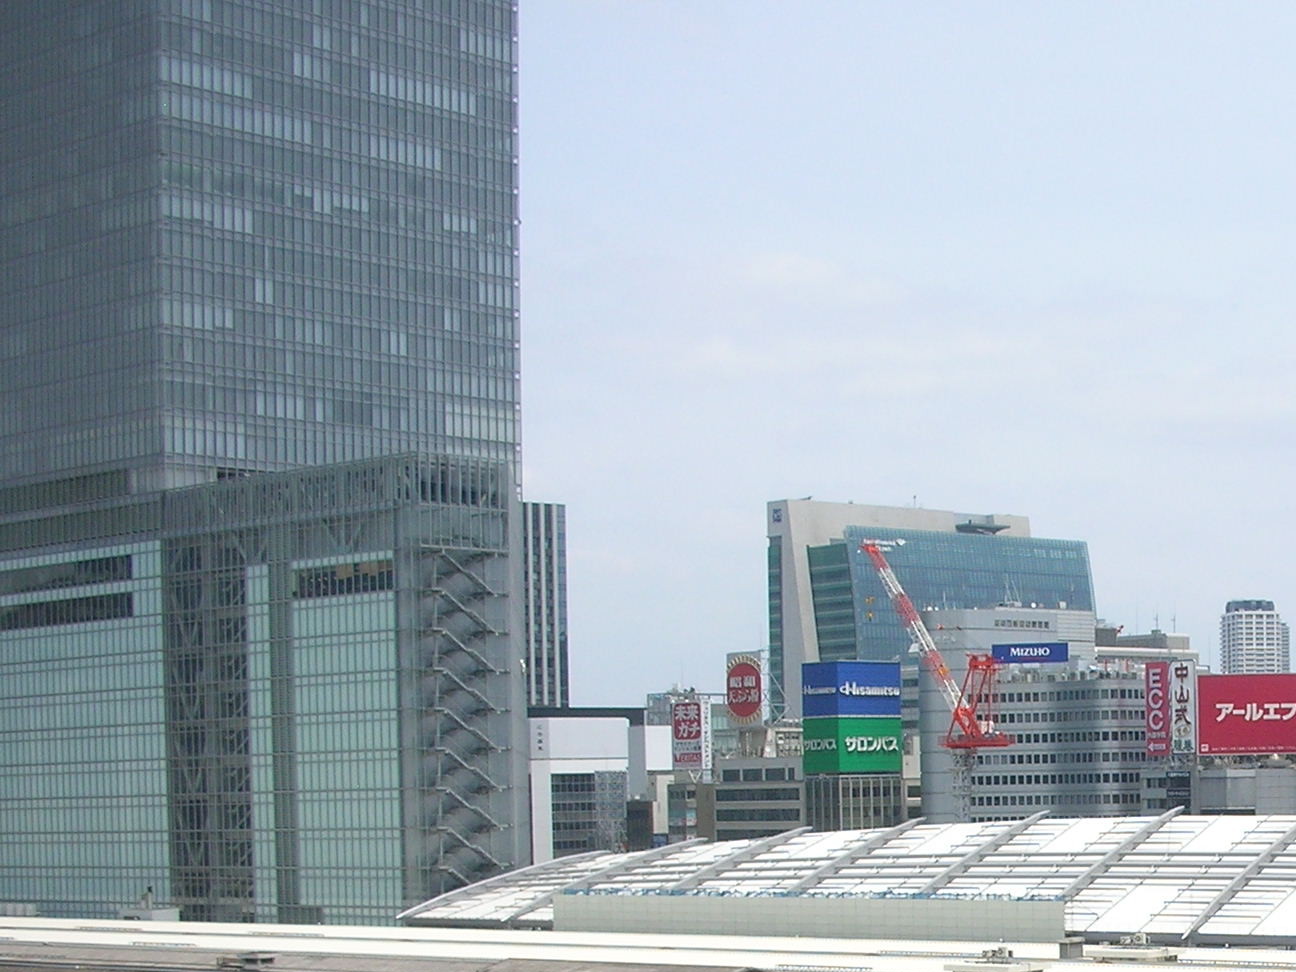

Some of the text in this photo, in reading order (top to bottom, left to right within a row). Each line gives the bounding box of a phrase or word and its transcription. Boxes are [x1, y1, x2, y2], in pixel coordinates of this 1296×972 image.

[1010, 647, 1050, 657] MIZUHO
[839, 681, 900, 696] Hisamitsu
[1148, 668, 1164, 730] ECC
[675, 704, 699, 720] 未来
[679, 721, 700, 738] ガチ
[804, 739, 837, 751] サロンパス
[844, 736, 900, 752] サロンパス
